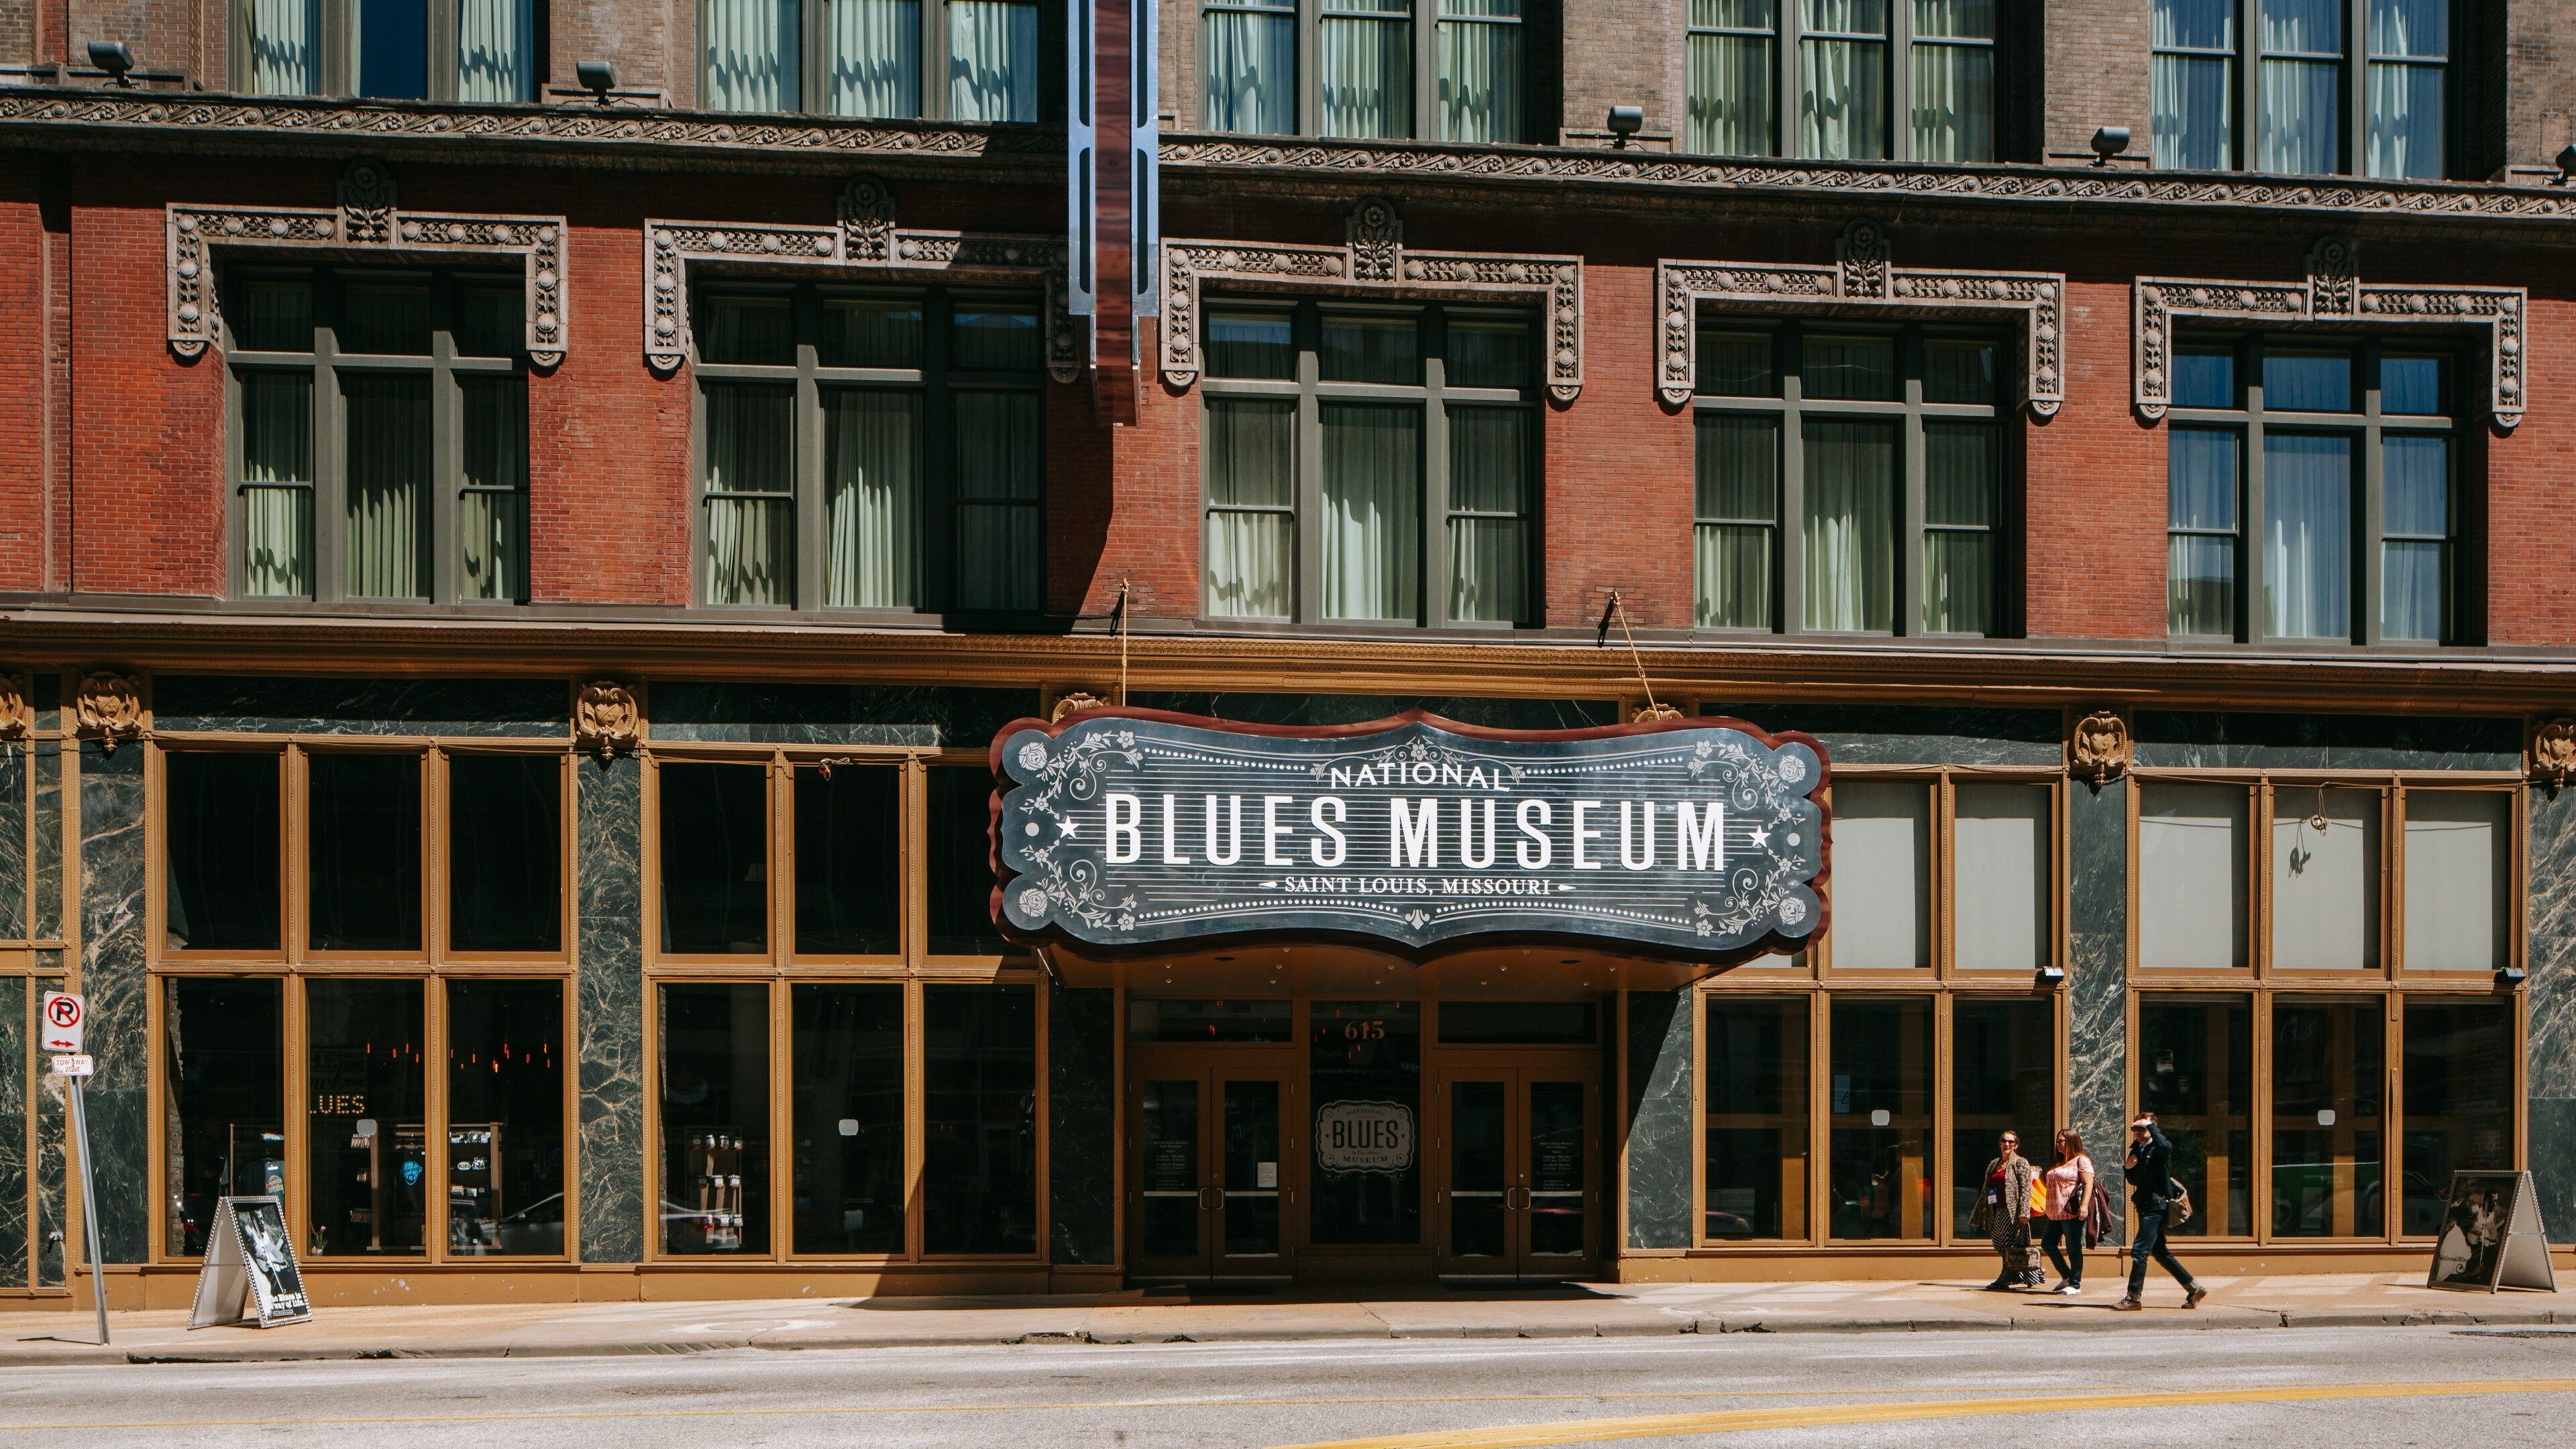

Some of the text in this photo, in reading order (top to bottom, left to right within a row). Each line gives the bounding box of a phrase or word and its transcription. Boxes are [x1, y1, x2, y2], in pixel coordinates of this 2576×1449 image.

[1331, 762, 1510, 792] NATIONAL
[1106, 794, 1724, 871] BLUES MUSEUM
[1285, 876, 1551, 896] SAINT LOUIS, MISSOURI
[1345, 1020, 1385, 1040] 615
[1332, 1120, 1399, 1148] BLUES
[1343, 1155, 1387, 1164] MUSEUM
[278, 1293, 294, 1301] Blues
[286, 1301, 292, 1309] of
